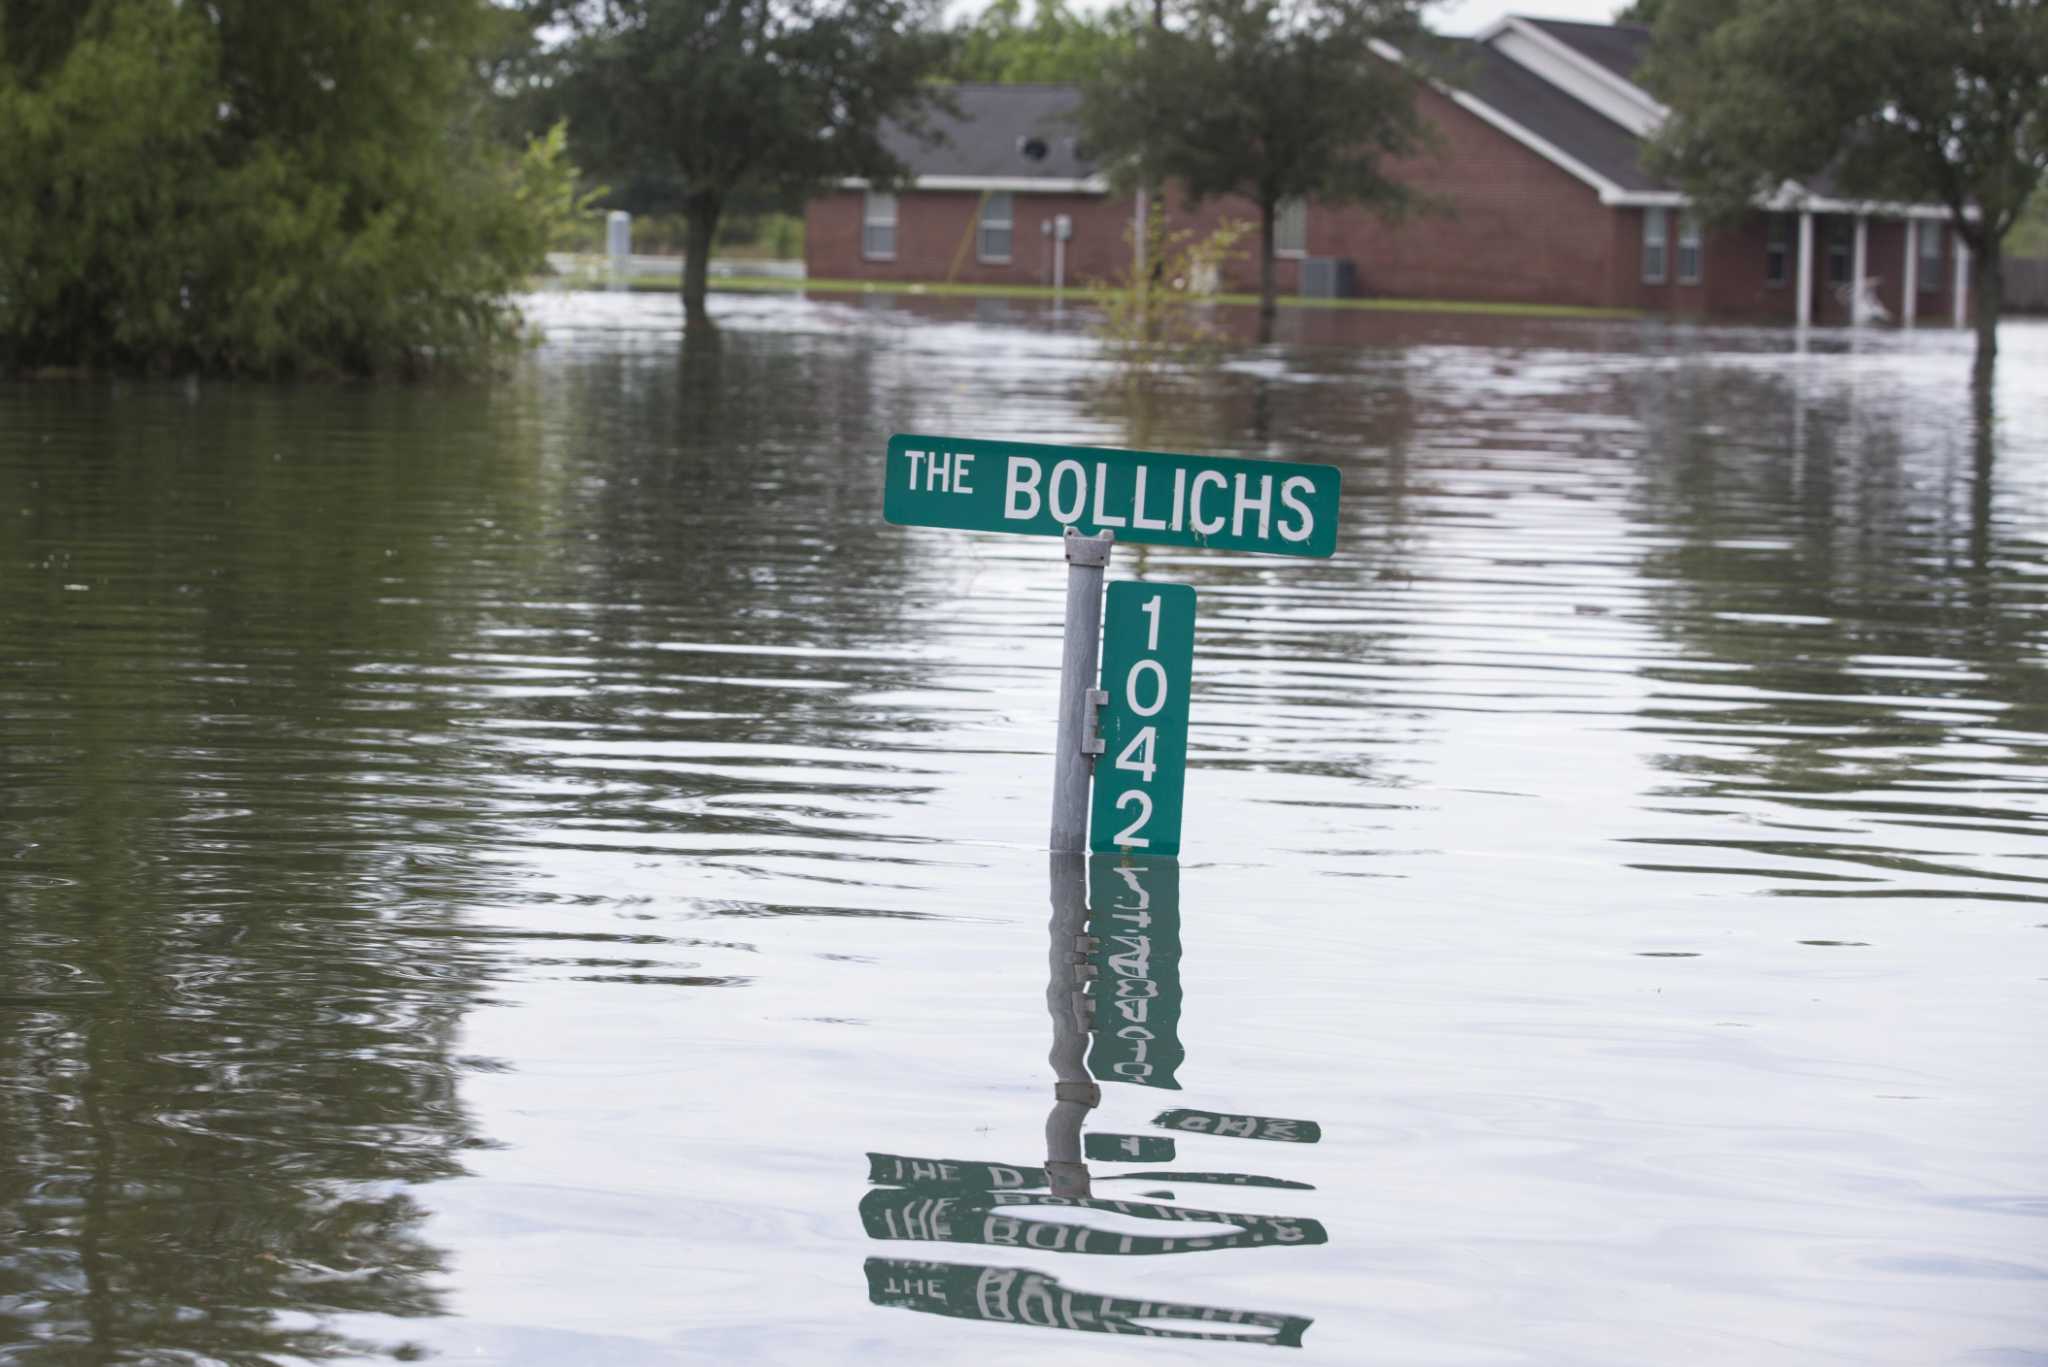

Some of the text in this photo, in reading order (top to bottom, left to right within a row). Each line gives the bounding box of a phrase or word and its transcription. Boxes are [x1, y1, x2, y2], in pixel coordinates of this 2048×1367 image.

[905, 450, 1316, 542] THE BOLLICHS
[1113, 595, 1168, 848] 1042
